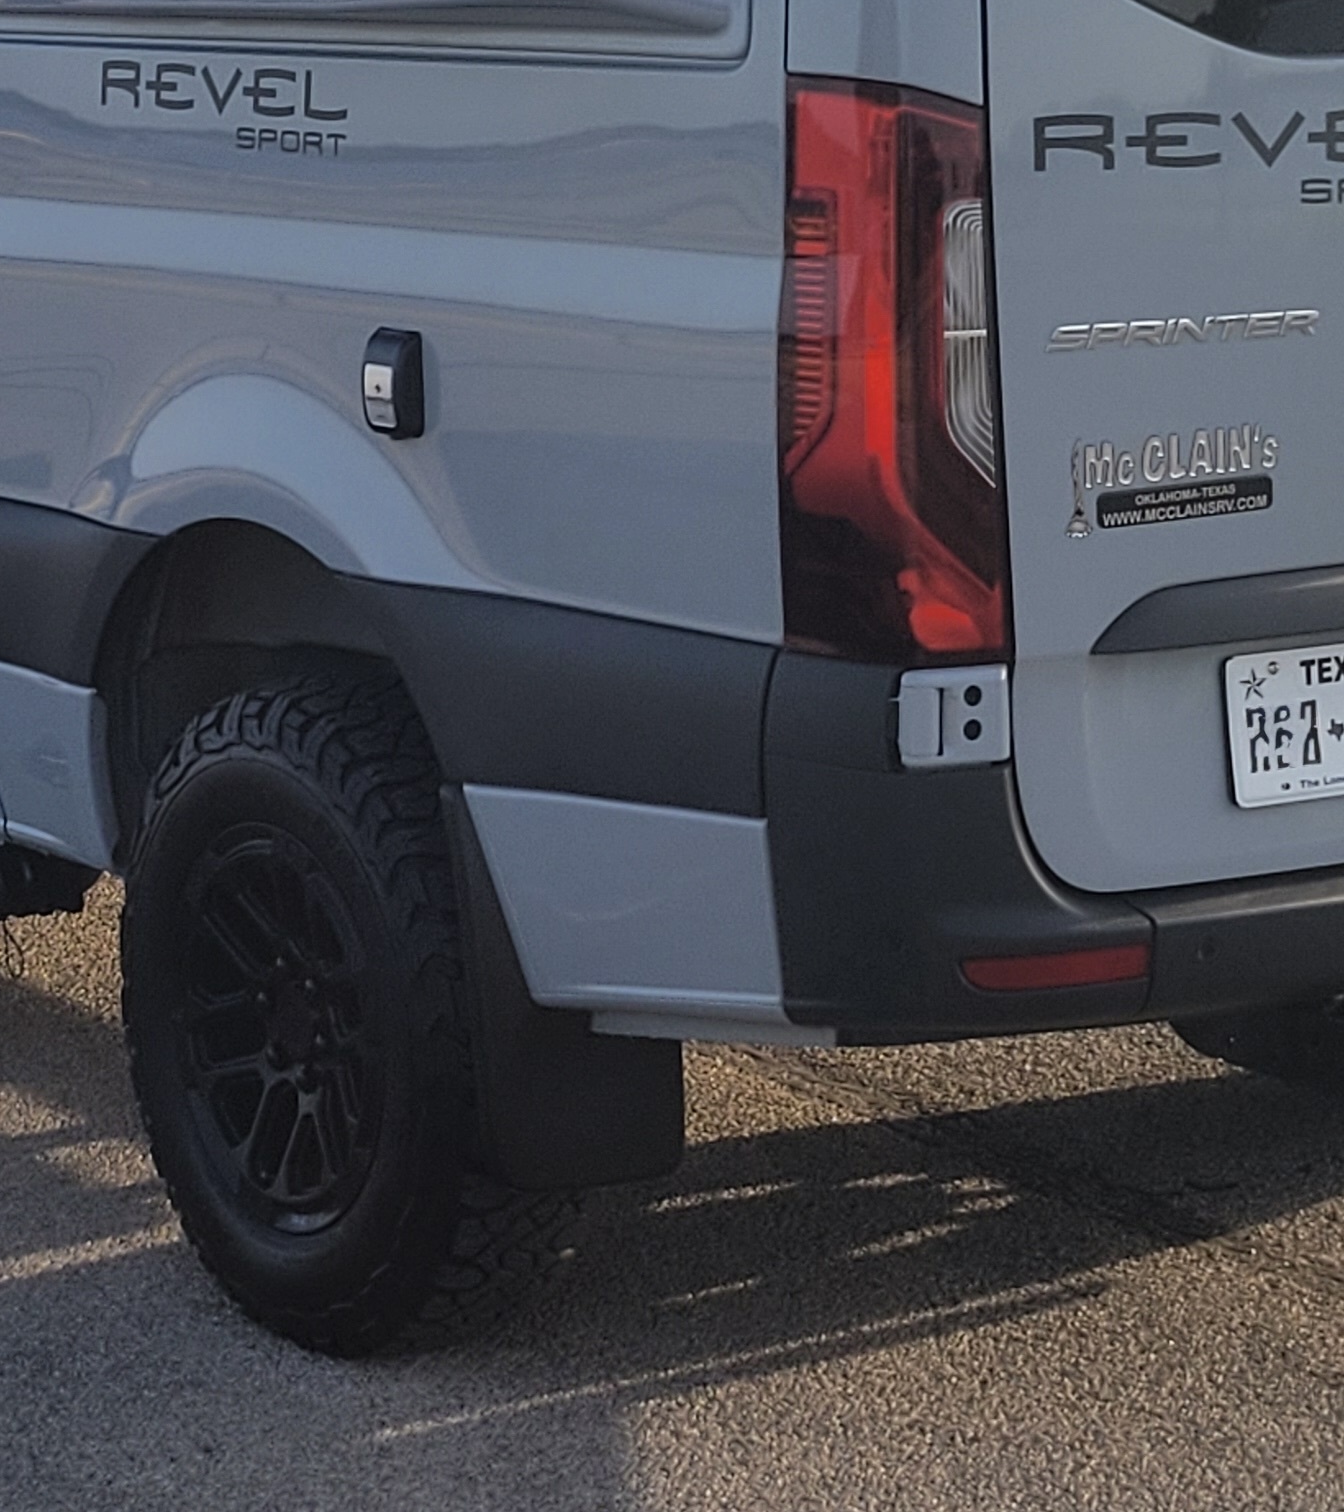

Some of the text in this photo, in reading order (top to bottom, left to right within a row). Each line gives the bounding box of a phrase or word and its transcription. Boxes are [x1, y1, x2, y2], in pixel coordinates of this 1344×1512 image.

[101, 60, 348, 121] REVEL
[236, 127, 348, 157] SPORT
[1046, 308, 1321, 353] SPRINTER
[1102, 493, 1269, 527] WWW.MCCLAINSRV.COM
